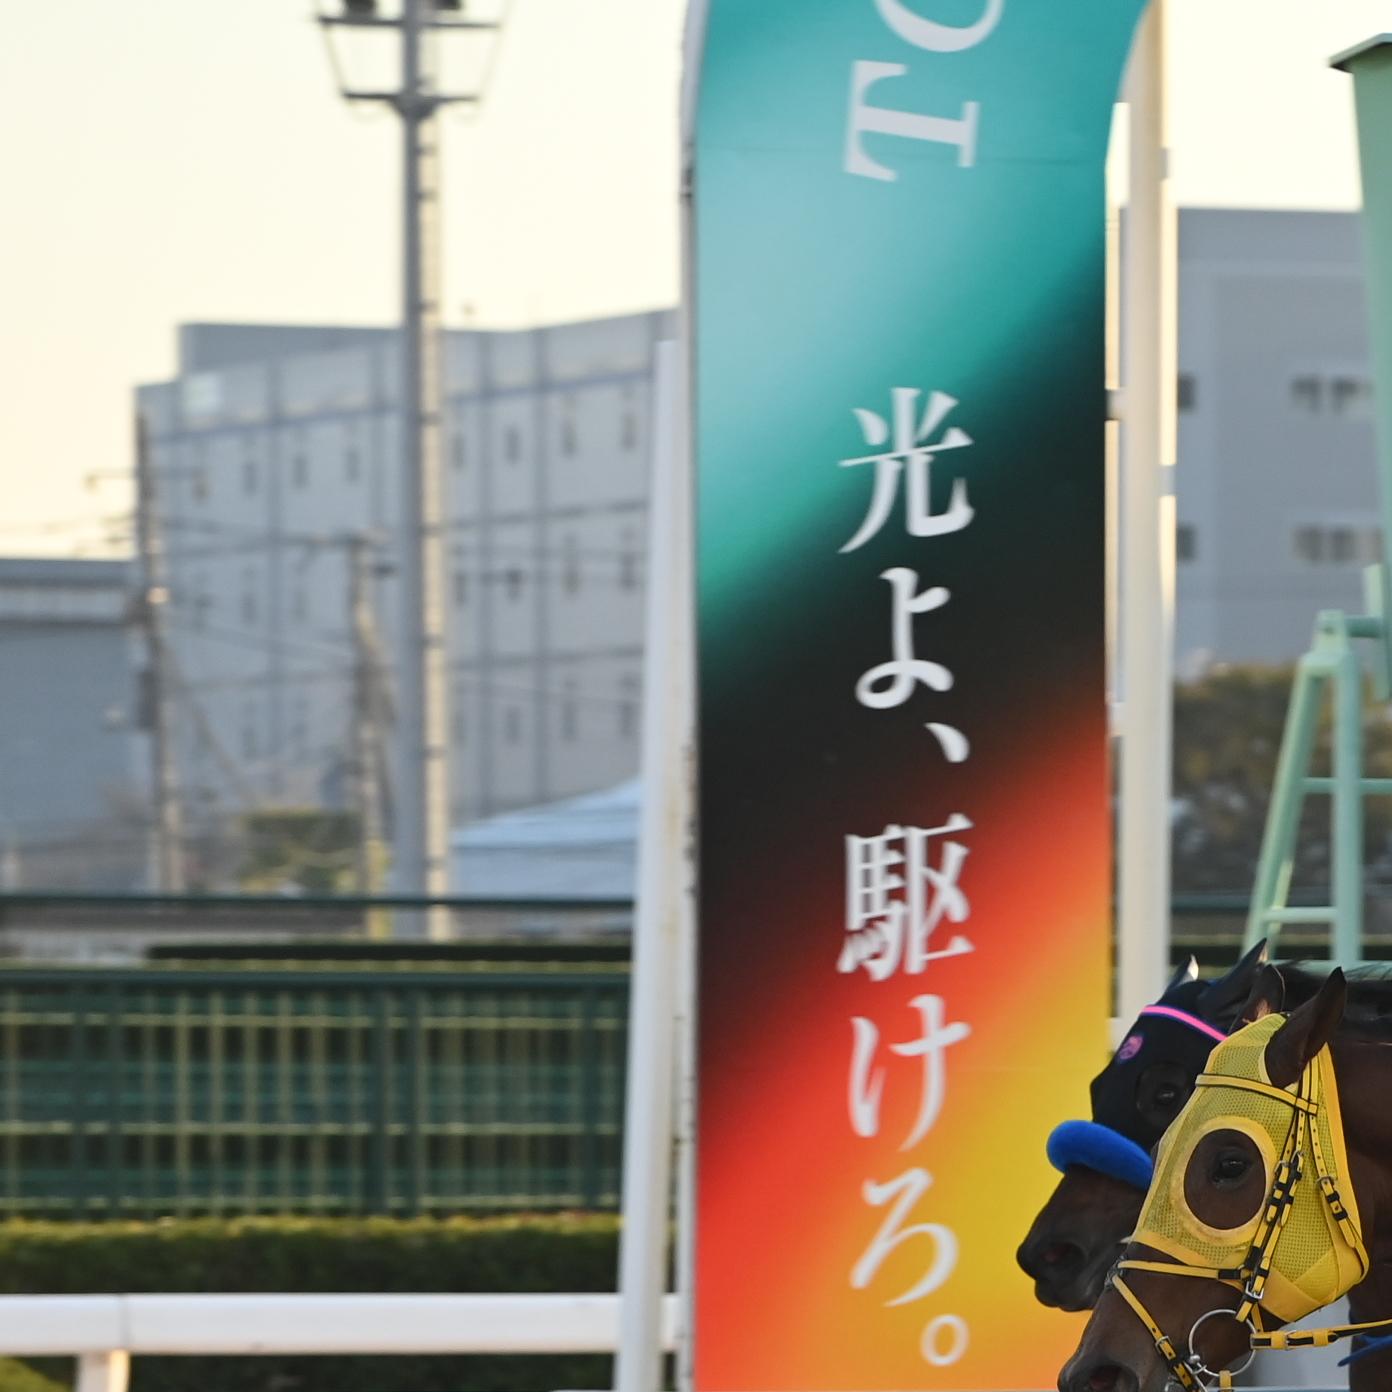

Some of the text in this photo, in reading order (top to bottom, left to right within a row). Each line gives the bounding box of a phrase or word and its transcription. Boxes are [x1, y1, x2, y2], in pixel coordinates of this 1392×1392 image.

[838, 386, 975, 1366] 光よ、駆けろ。
